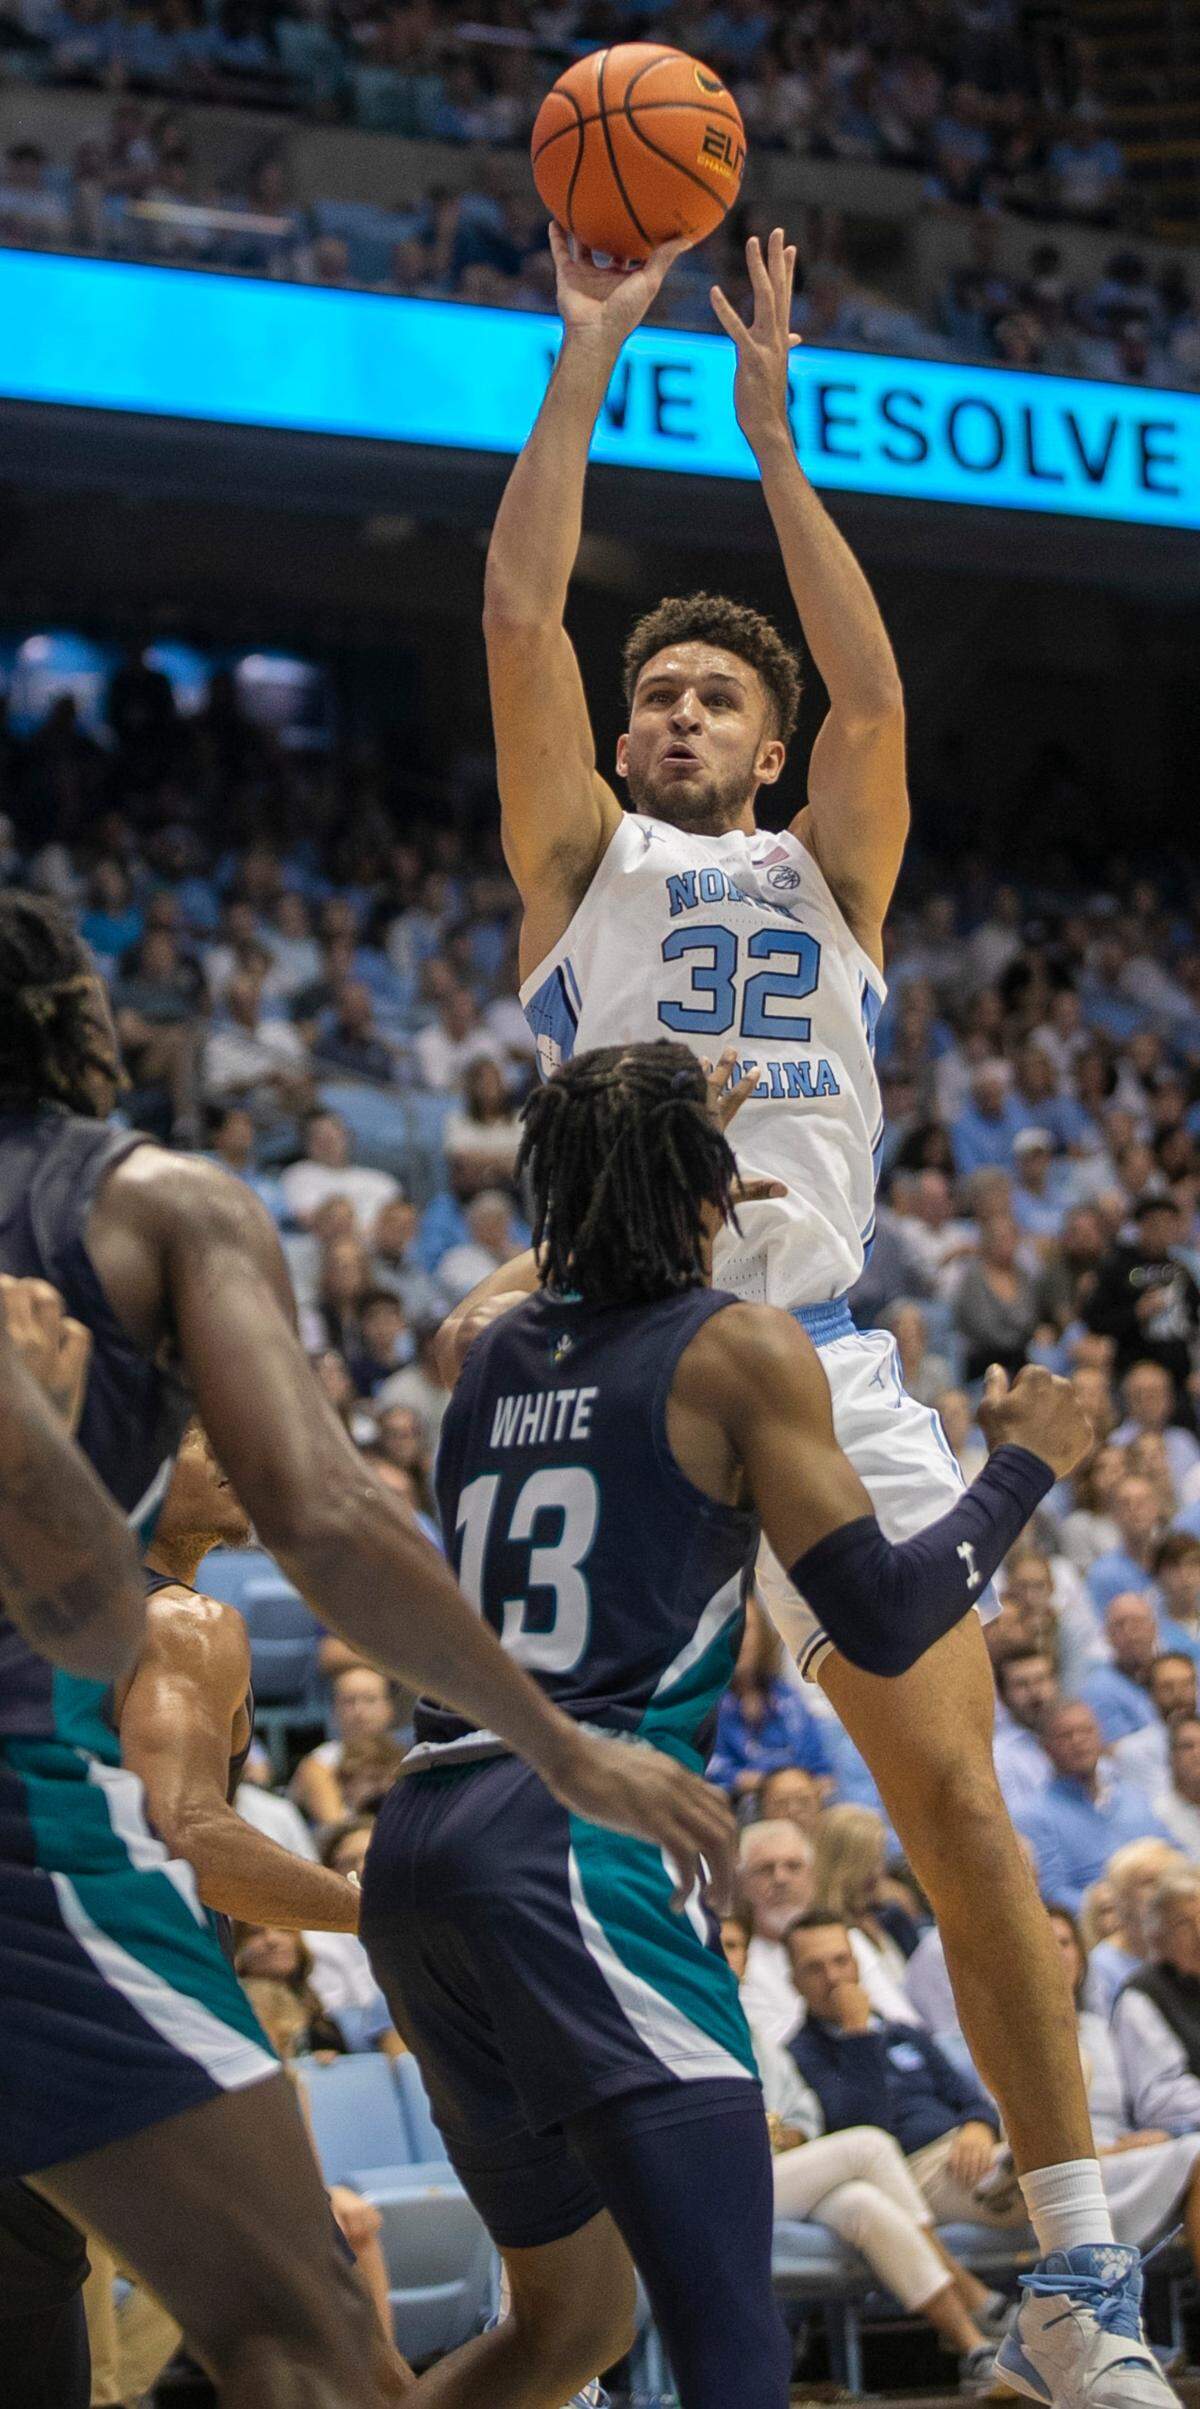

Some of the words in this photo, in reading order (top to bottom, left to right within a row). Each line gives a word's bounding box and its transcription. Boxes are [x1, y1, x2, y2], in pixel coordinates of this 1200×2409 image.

[787, 380, 1181, 496] ESOLVE
[657, 924, 821, 1042] 32
[489, 1386, 599, 1449] WHITE
[455, 1466, 600, 1674] 13
